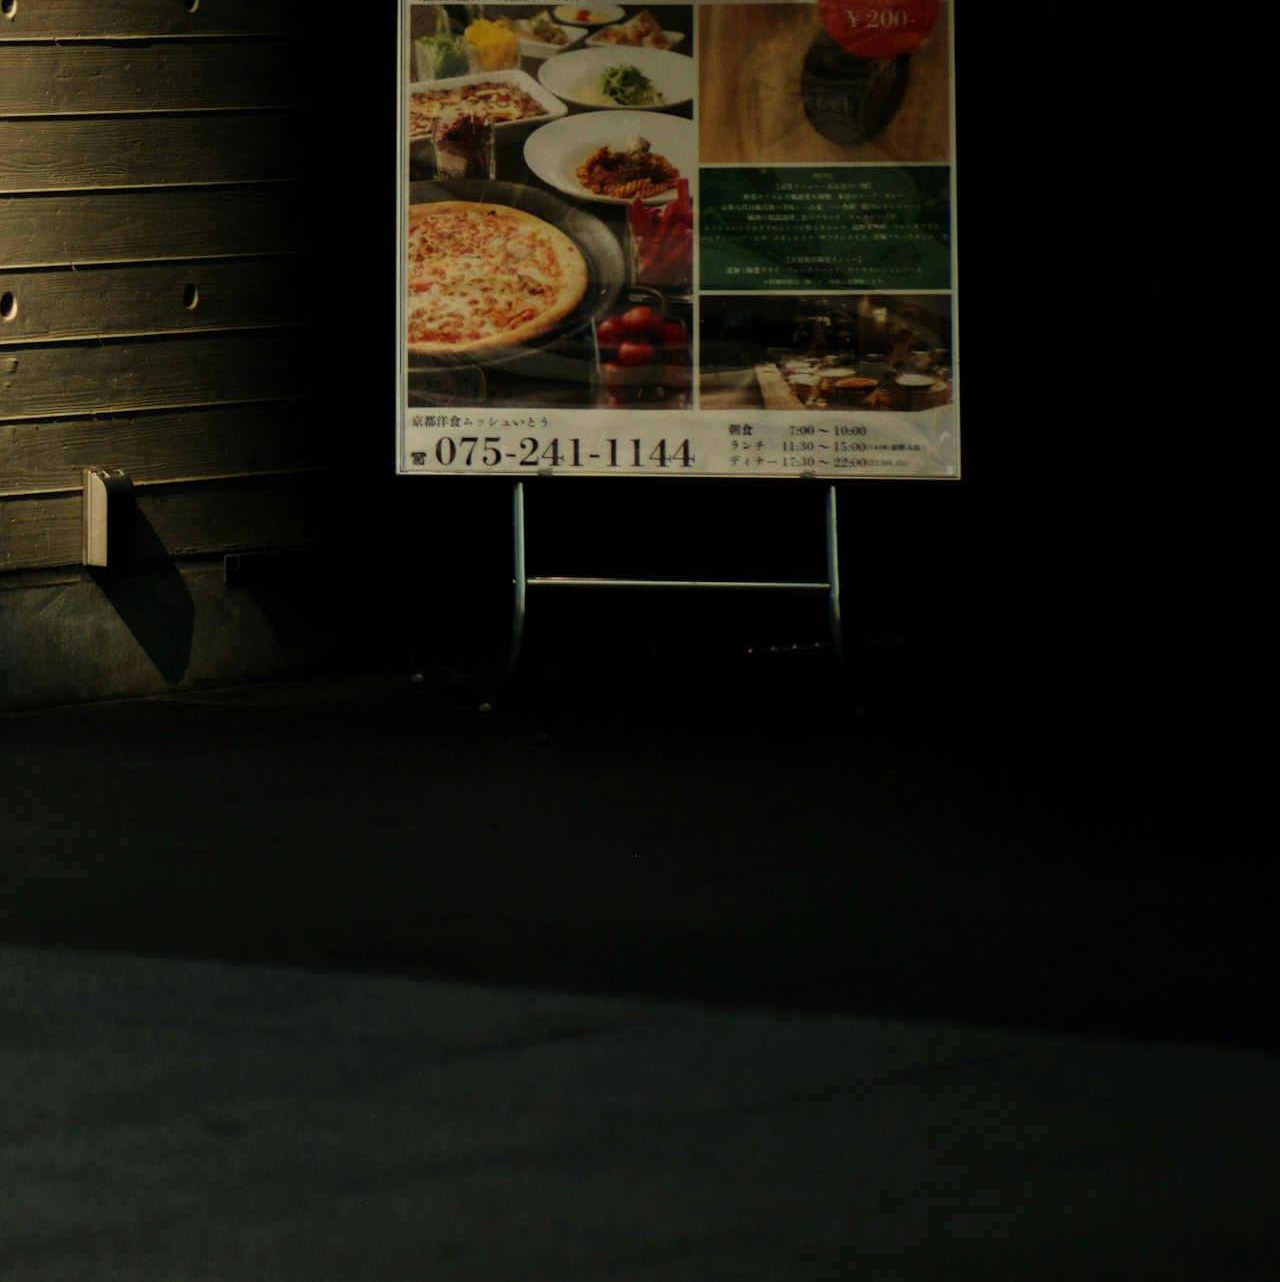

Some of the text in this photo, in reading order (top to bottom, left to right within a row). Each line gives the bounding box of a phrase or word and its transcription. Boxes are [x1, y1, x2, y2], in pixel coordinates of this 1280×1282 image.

[411, 415, 549, 429] 京都洋食ムッシュいとう
[728, 423, 753, 436] 朝食
[788, 425, 815, 437] 7:00
[833, 425, 867, 437] 10:00
[435, 435, 696, 468] 075-241-1144
[730, 440, 766, 452] ランチ
[781, 440, 814, 453] 11:30
[833, 441, 867, 453] 15:00
[730, 455, 778, 467] ディナー
[781, 456, 815, 468] 17:30
[832, 456, 867, 469] 22:00
